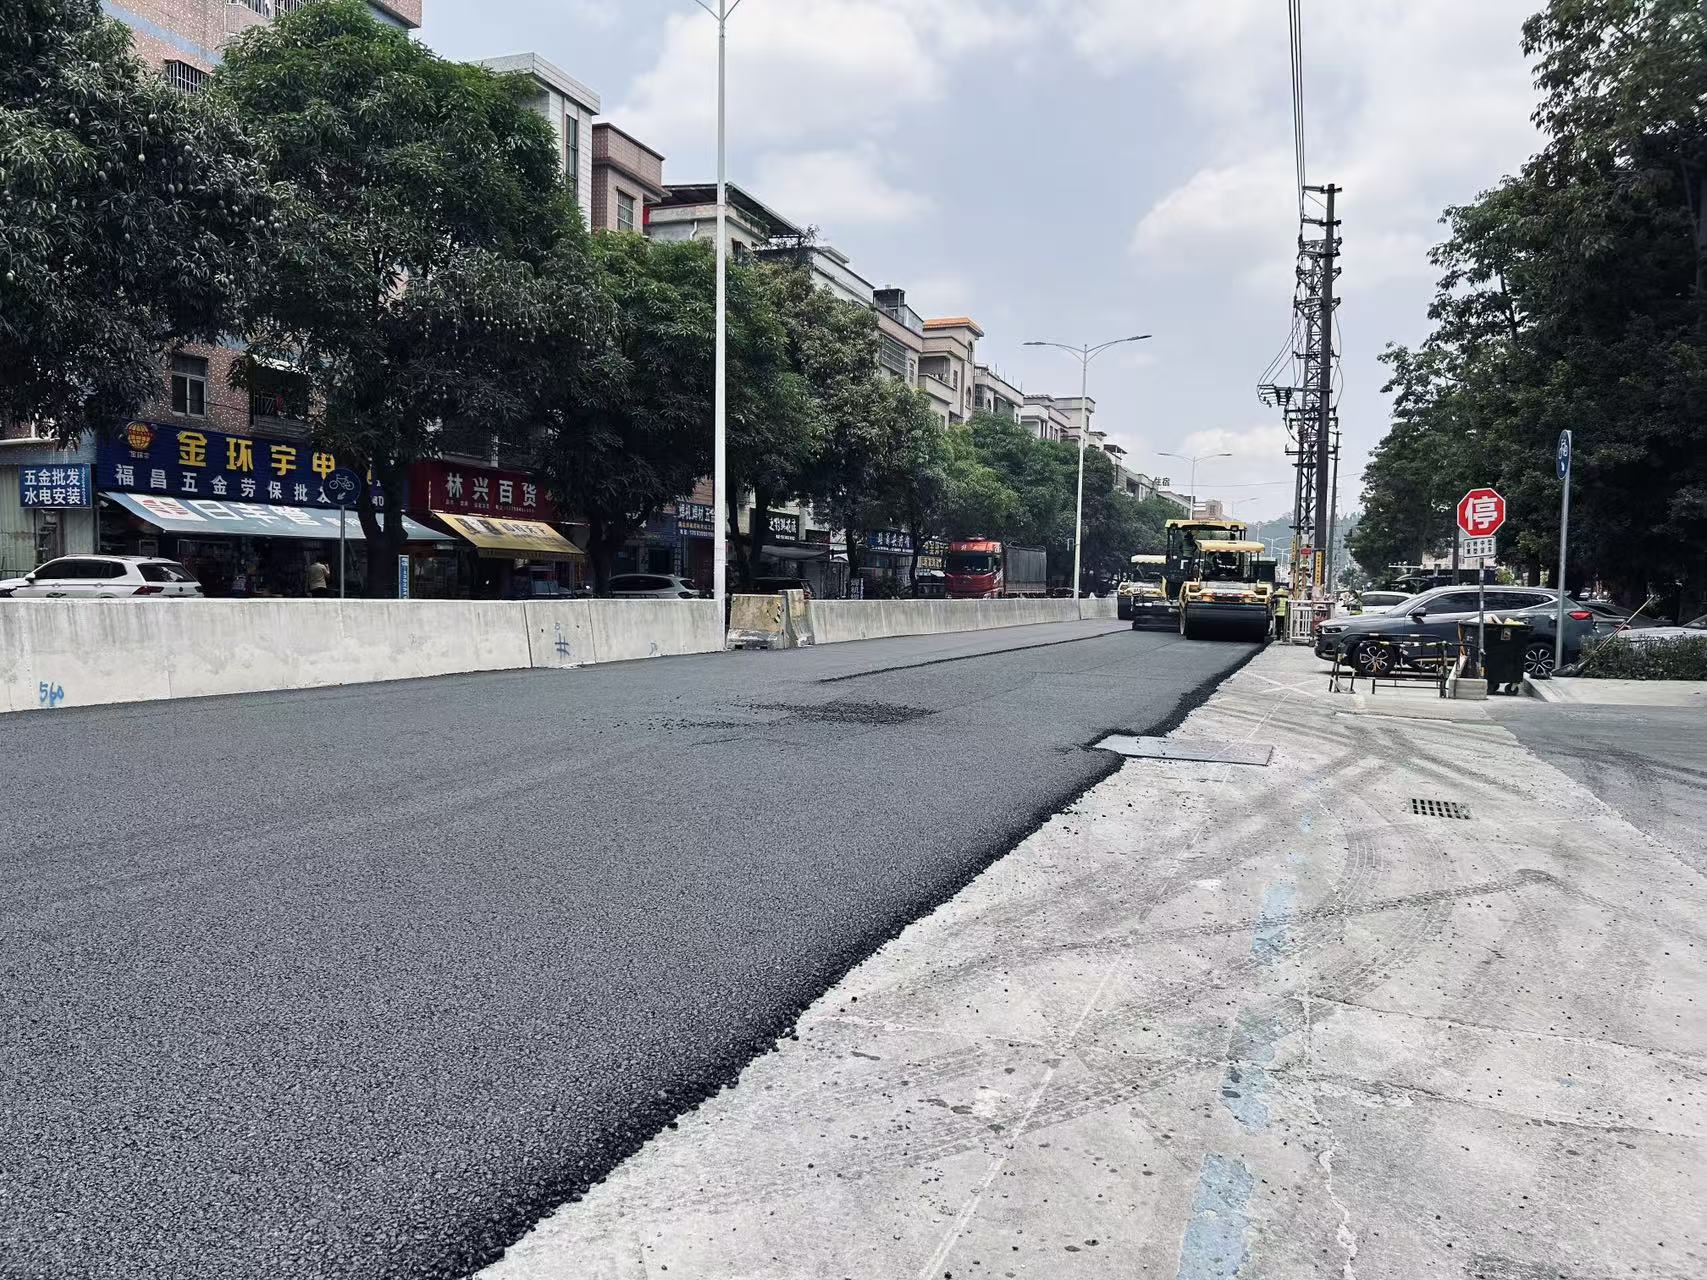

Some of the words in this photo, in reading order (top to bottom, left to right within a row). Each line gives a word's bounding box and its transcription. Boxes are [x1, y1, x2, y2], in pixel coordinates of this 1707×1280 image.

[24, 468, 81, 486] 五金批发
[445, 472, 537, 507] 林兴百货
[24, 487, 81, 505] 水电安装
[1465, 495, 1498, 530] 停
[39, 681, 65, 706] 560
